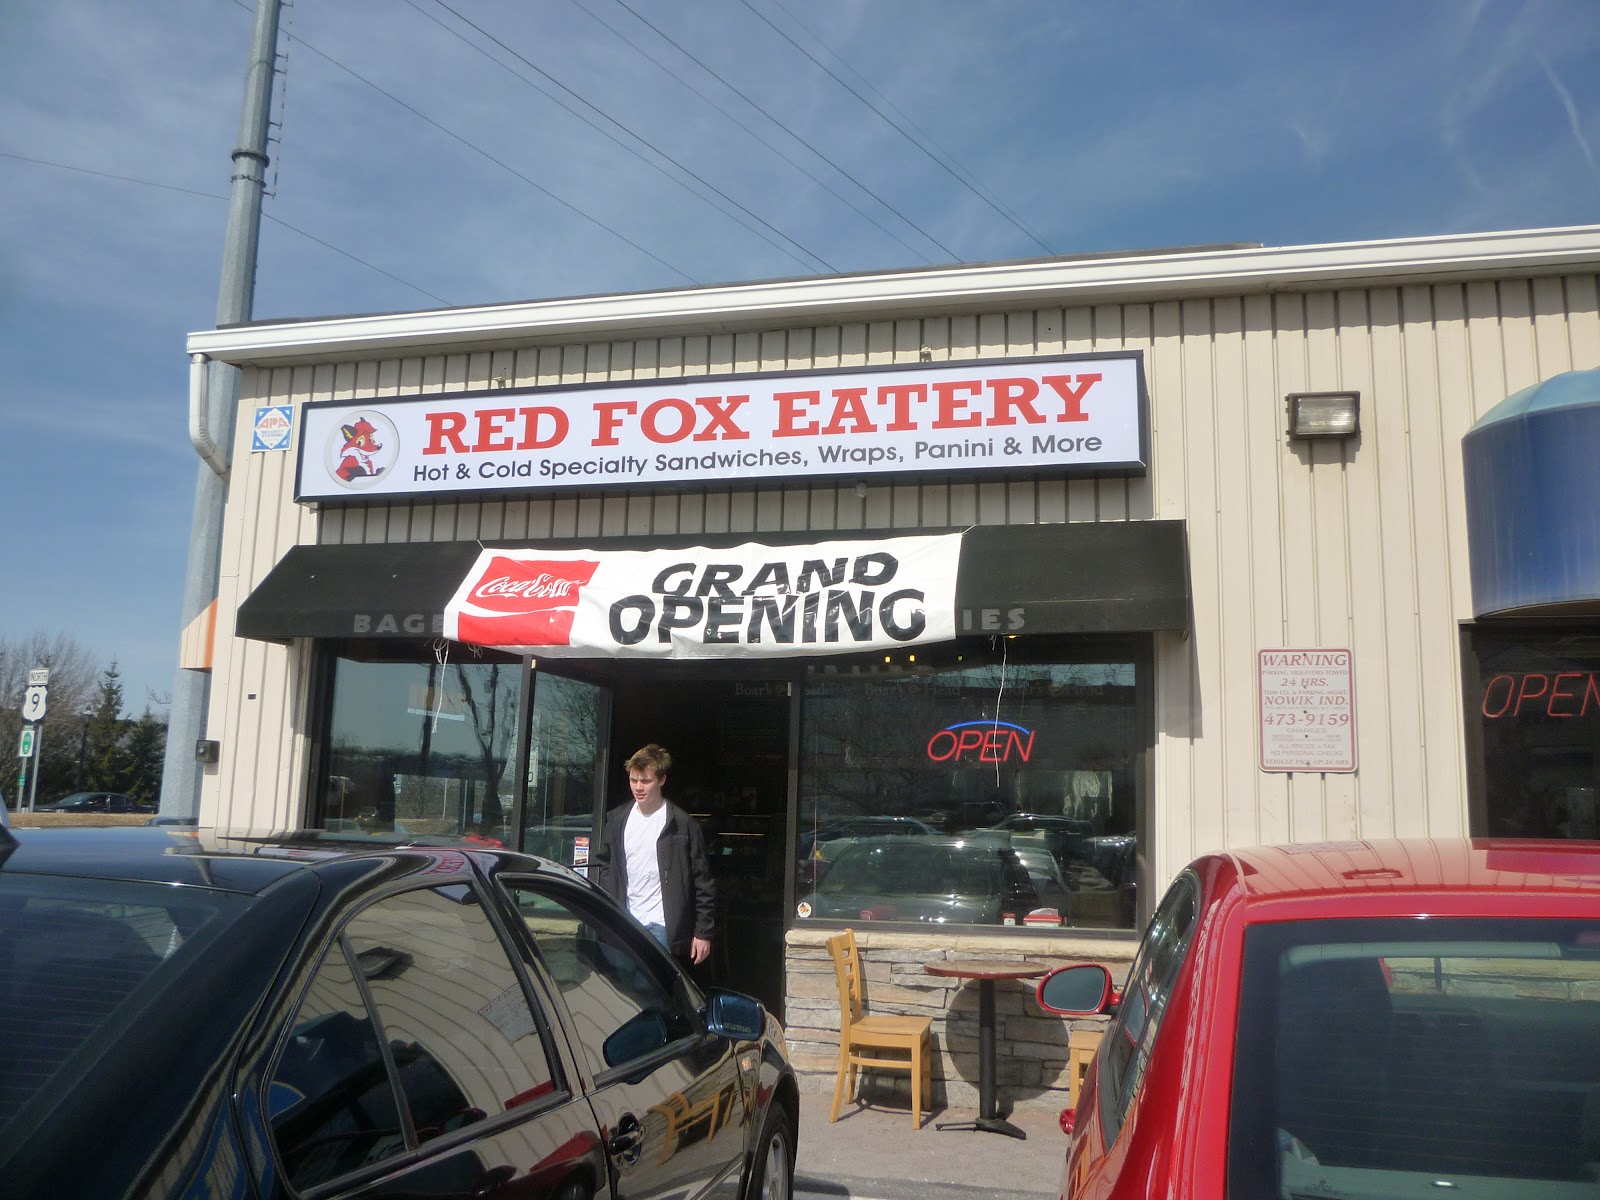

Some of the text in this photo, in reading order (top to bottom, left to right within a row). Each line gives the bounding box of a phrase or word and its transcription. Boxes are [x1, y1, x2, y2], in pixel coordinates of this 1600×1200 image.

[422, 373, 1103, 456] RED FOX EATERY
[413, 433, 1103, 482] Hot & Cold Specialty Sandwiches, Wraps, Panini & More
[475, 573, 587, 598] Coca-Cola
[652, 551, 899, 597] GRAND
[608, 588, 927, 646] OPENING
[1262, 654, 1347, 667] WARNING
[1280, 678, 1329, 687] 24 HRS.
[32, 692, 40, 712] 9
[1264, 696, 1349, 705] NOWIK IND.
[1264, 713, 1350, 726] 473-9159
[927, 730, 1036, 762] OPEN
